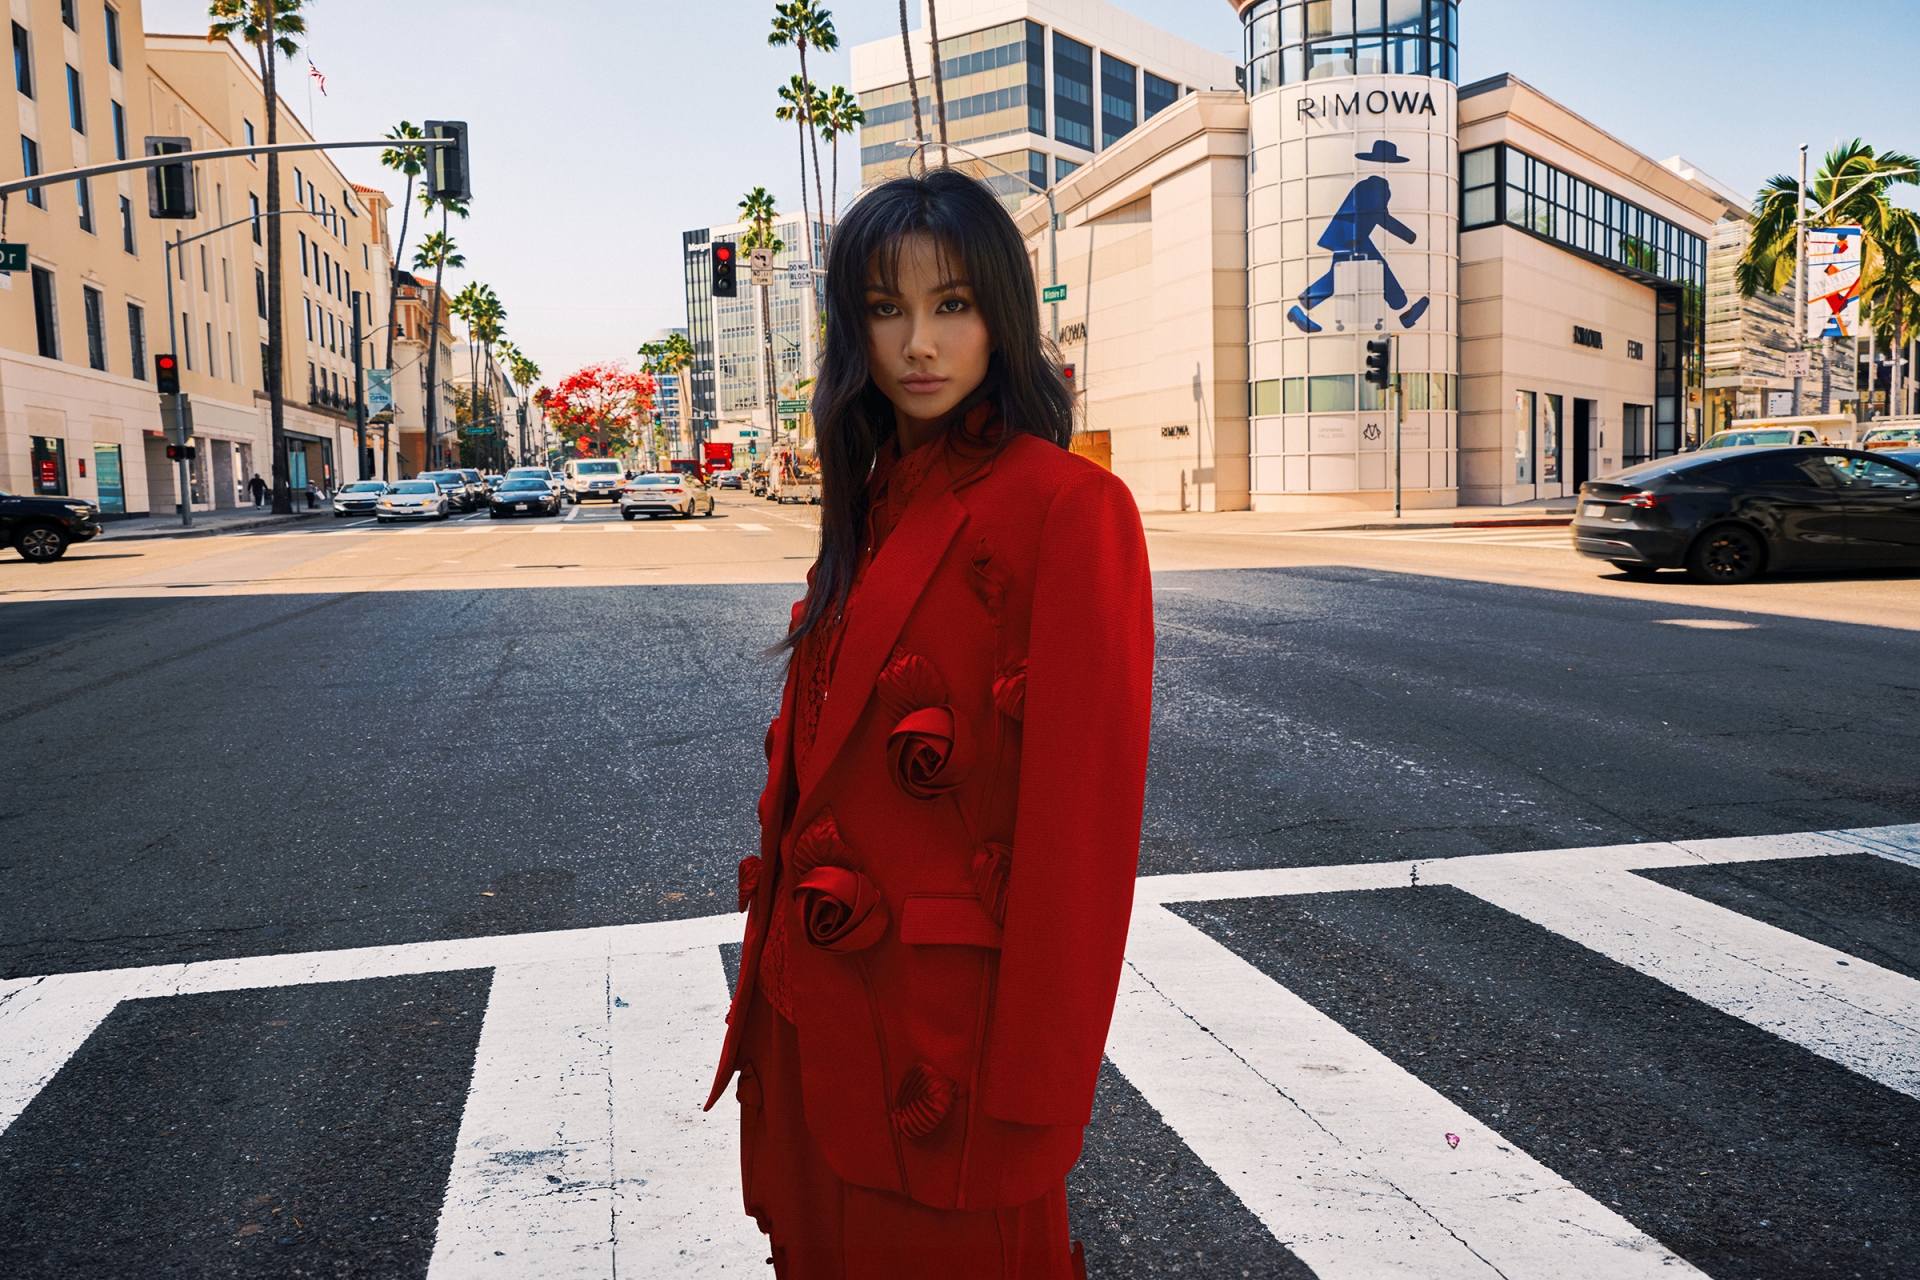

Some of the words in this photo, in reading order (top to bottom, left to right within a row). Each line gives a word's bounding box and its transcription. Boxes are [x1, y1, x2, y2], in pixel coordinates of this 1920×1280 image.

[1297, 90, 1436, 121] RIMOWA
[1627, 339, 1643, 361] FENDI
[1161, 425, 1190, 437] RIMOWA
